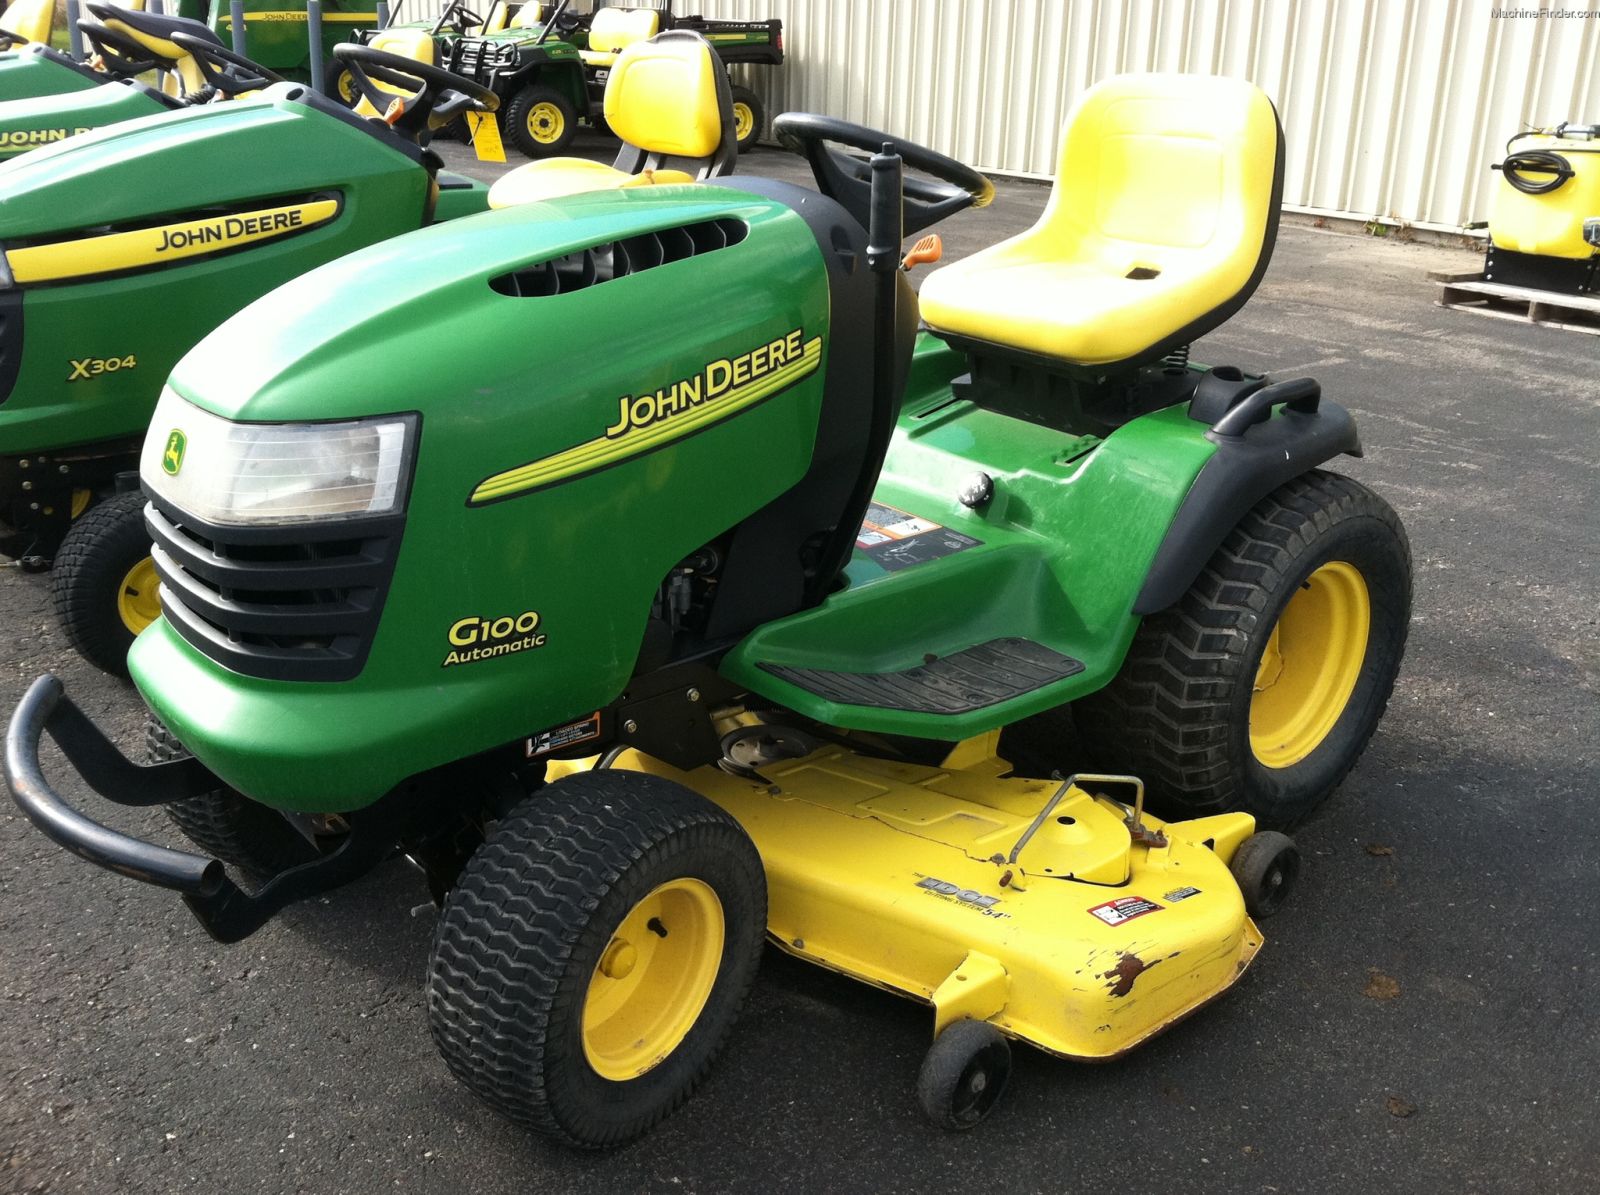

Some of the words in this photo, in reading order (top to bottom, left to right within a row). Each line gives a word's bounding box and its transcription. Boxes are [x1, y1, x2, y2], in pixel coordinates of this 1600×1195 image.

[285, 12, 308, 21] DEER
[0, 128, 66, 145] JOHN
[156, 225, 222, 252] JOHN
[225, 209, 302, 239] DEERE
[68, 354, 137, 380] X304
[606, 374, 701, 437] JOHN
[705, 328, 802, 398] DEERE
[448, 611, 539, 646] G100
[443, 634, 545, 667] Automatic
